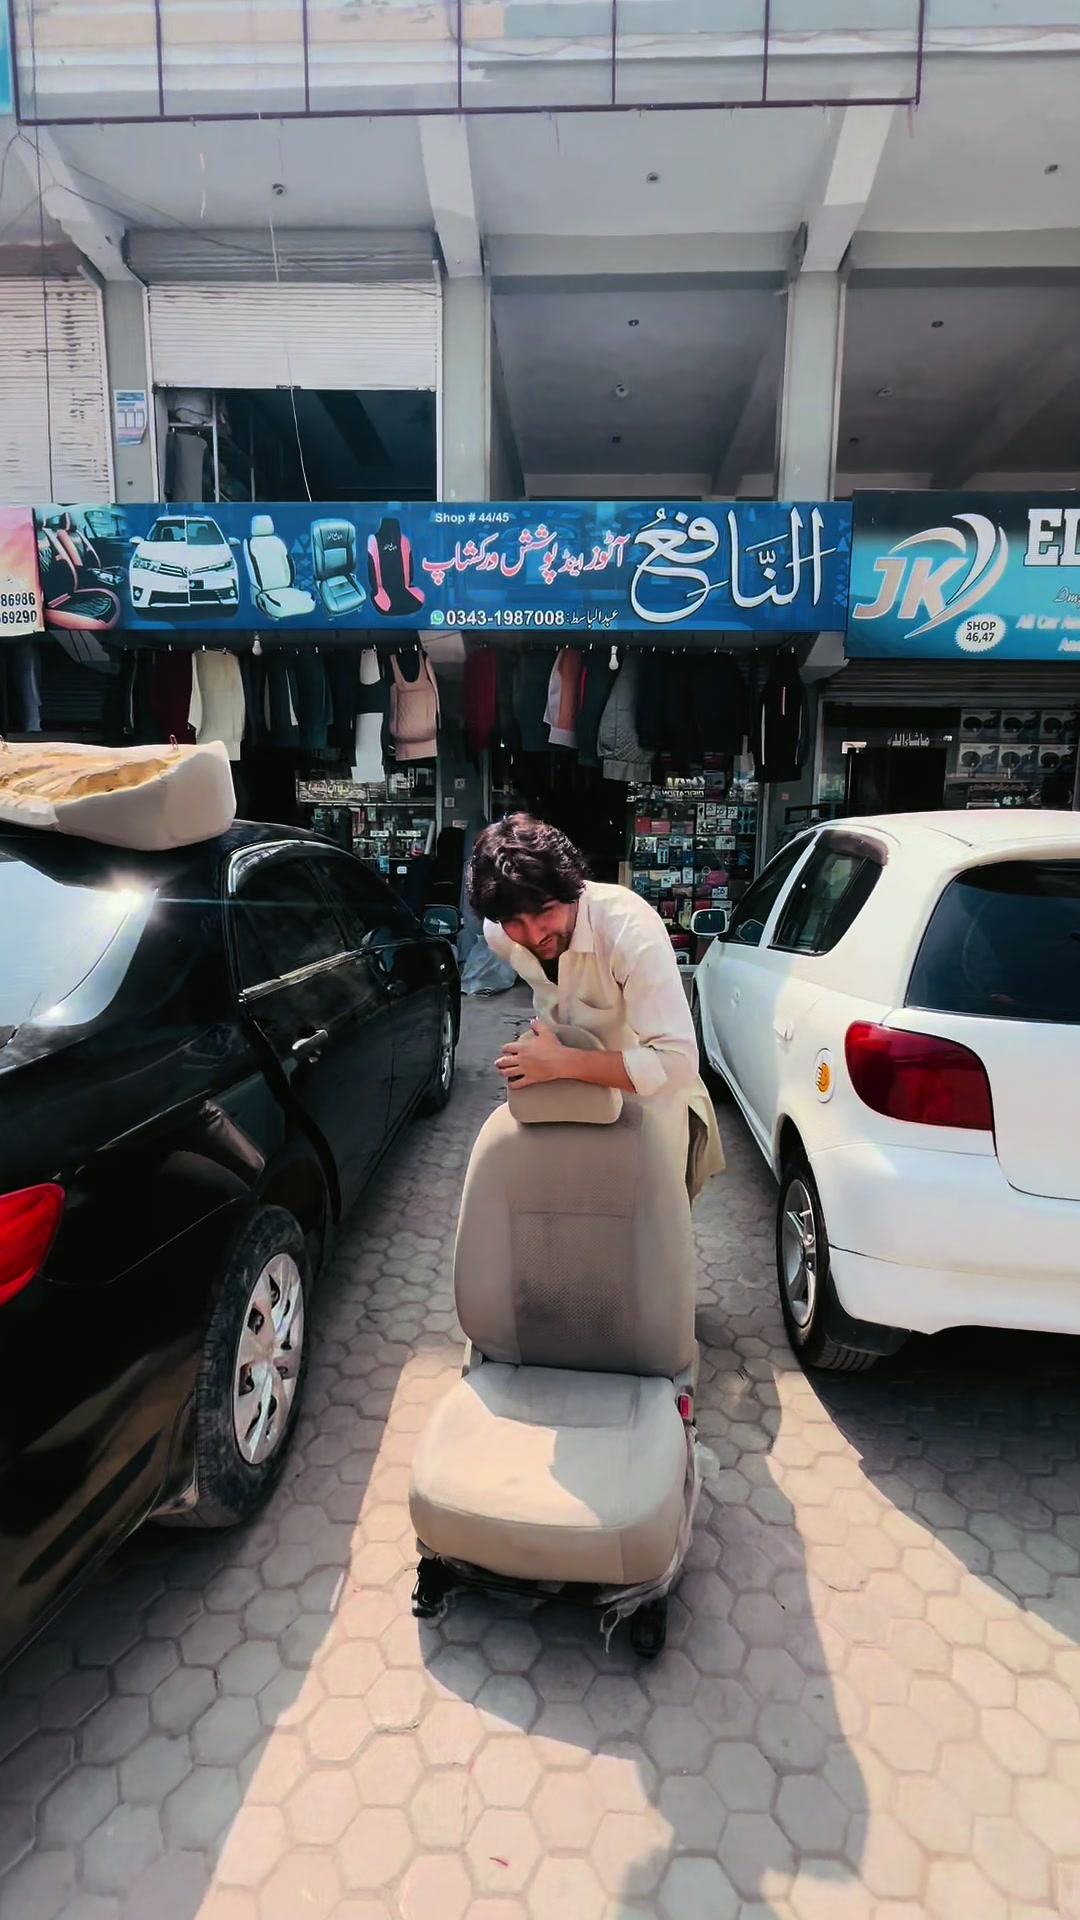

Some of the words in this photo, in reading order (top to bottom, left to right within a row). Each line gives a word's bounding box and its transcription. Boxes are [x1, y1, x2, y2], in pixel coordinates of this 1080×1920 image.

[435, 512, 466, 526] Shop
[468, 513, 475, 523] #
[479, 512, 510, 523] 44/45
[852, 556, 968, 619] JK
[0, 591, 36, 607] 86986
[0, 609, 37, 625] 69290
[446, 609, 565, 626] 0343-1987008
[966, 621, 996, 631] SHOP
[965, 632, 995, 643] 46,47
